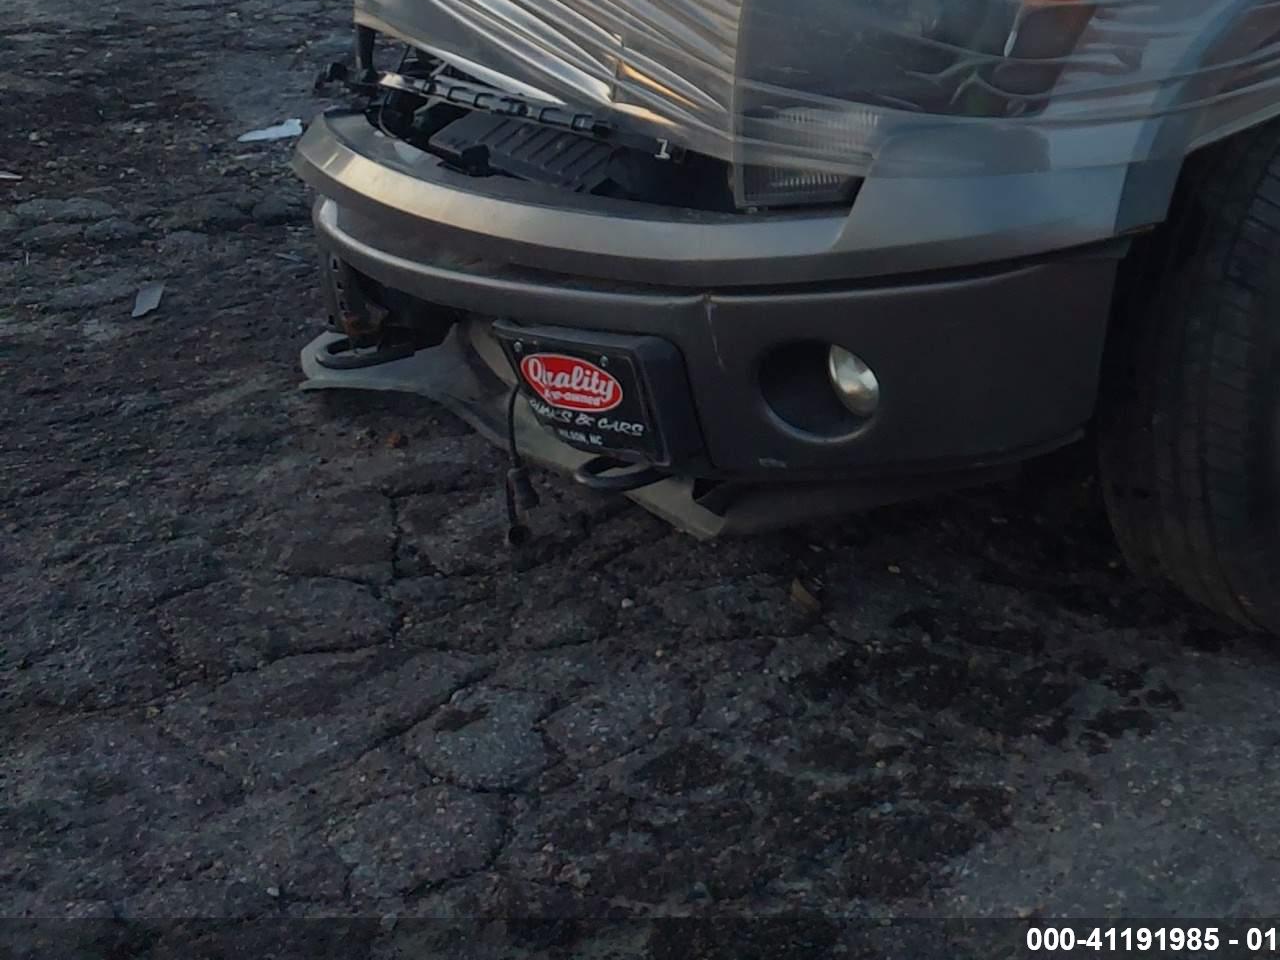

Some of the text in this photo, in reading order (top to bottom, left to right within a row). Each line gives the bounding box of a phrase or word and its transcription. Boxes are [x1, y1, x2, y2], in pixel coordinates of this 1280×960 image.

[528, 357, 614, 404] Quality
[575, 413, 596, 427] &
[597, 417, 645, 437] CARS
